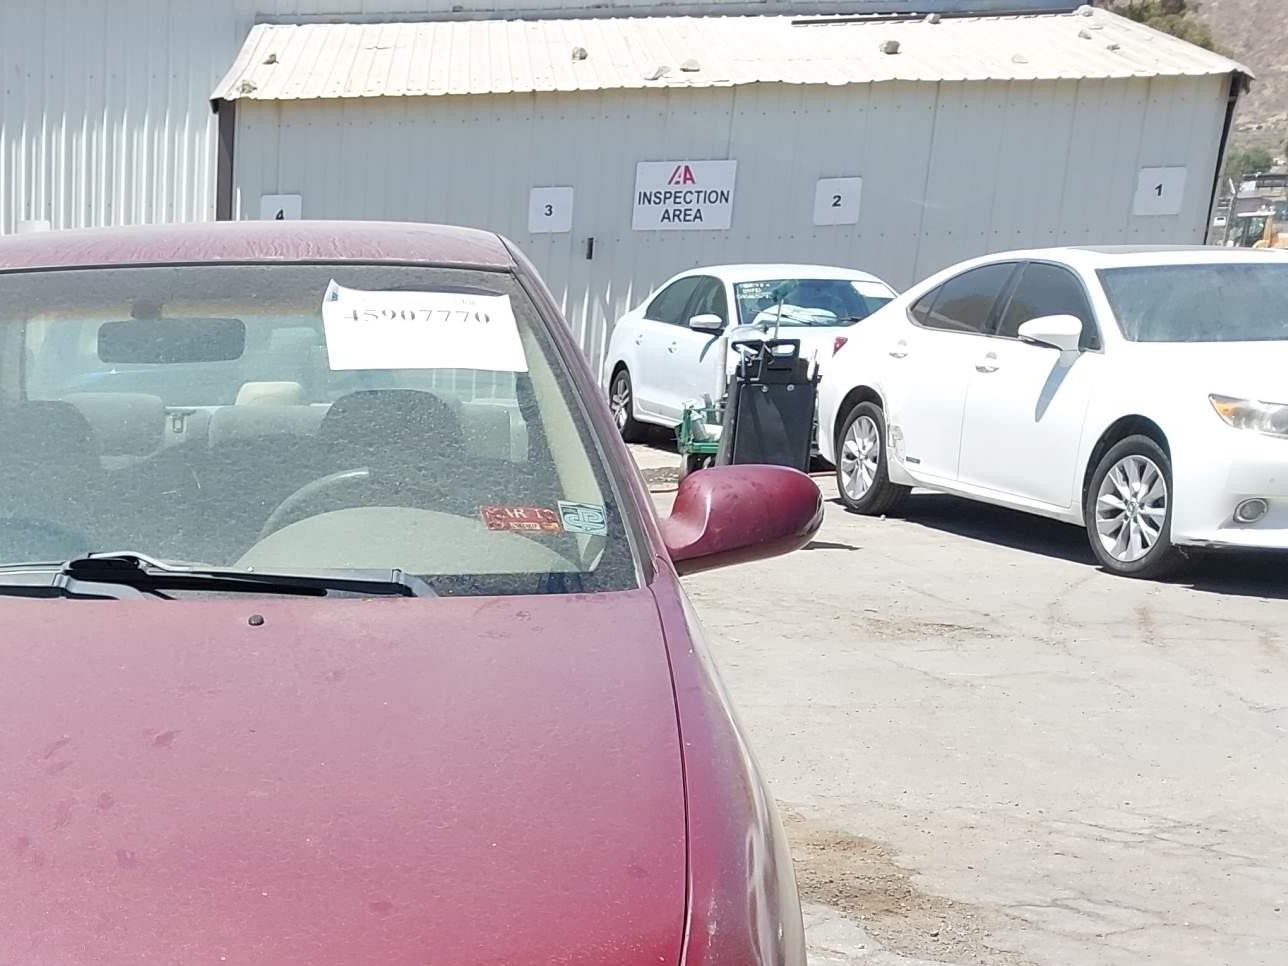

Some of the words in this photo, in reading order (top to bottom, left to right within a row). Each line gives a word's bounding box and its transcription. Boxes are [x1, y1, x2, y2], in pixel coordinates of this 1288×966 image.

[1155, 183, 1163, 197] 1
[638, 190, 730, 205] INSPECTION
[831, 195, 842, 208] 2
[275, 208, 285, 220] 4
[544, 204, 553, 217] 3
[660, 208, 704, 223] AREA
